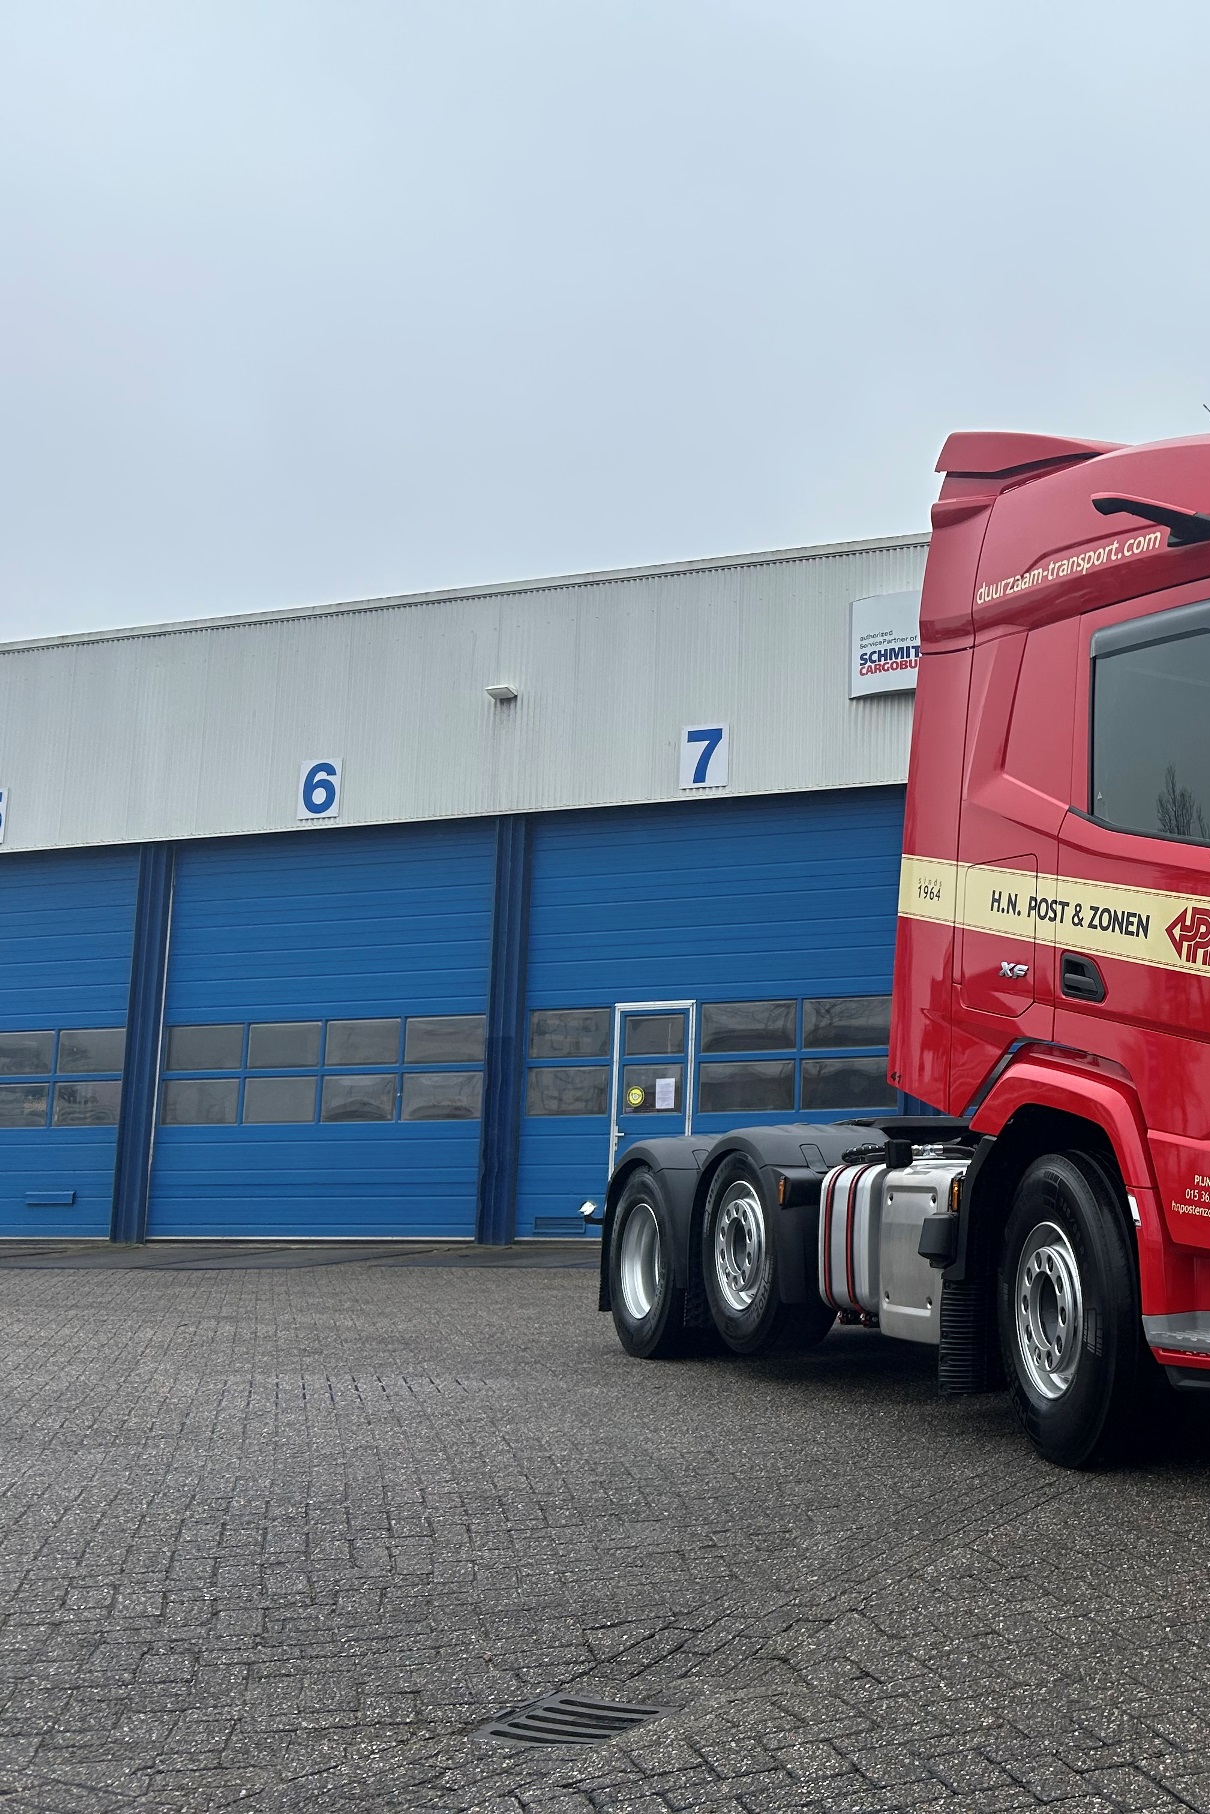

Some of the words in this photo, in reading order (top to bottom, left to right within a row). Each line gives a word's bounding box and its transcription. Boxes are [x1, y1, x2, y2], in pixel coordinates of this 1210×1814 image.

[976, 531, 1162, 604] duurzaam-transport.com
[687, 728, 723, 784] 7
[302, 762, 337, 814] 6
[917, 884, 941, 901] 1964
[990, 889, 1022, 917] H.N.
[1027, 895, 1070, 924] POST
[1071, 903, 1085, 928] &
[1087, 905, 1151, 939] ZONEN
[999, 961, 1029, 979] XF
[1185, 1188, 1199, 1201] 015
